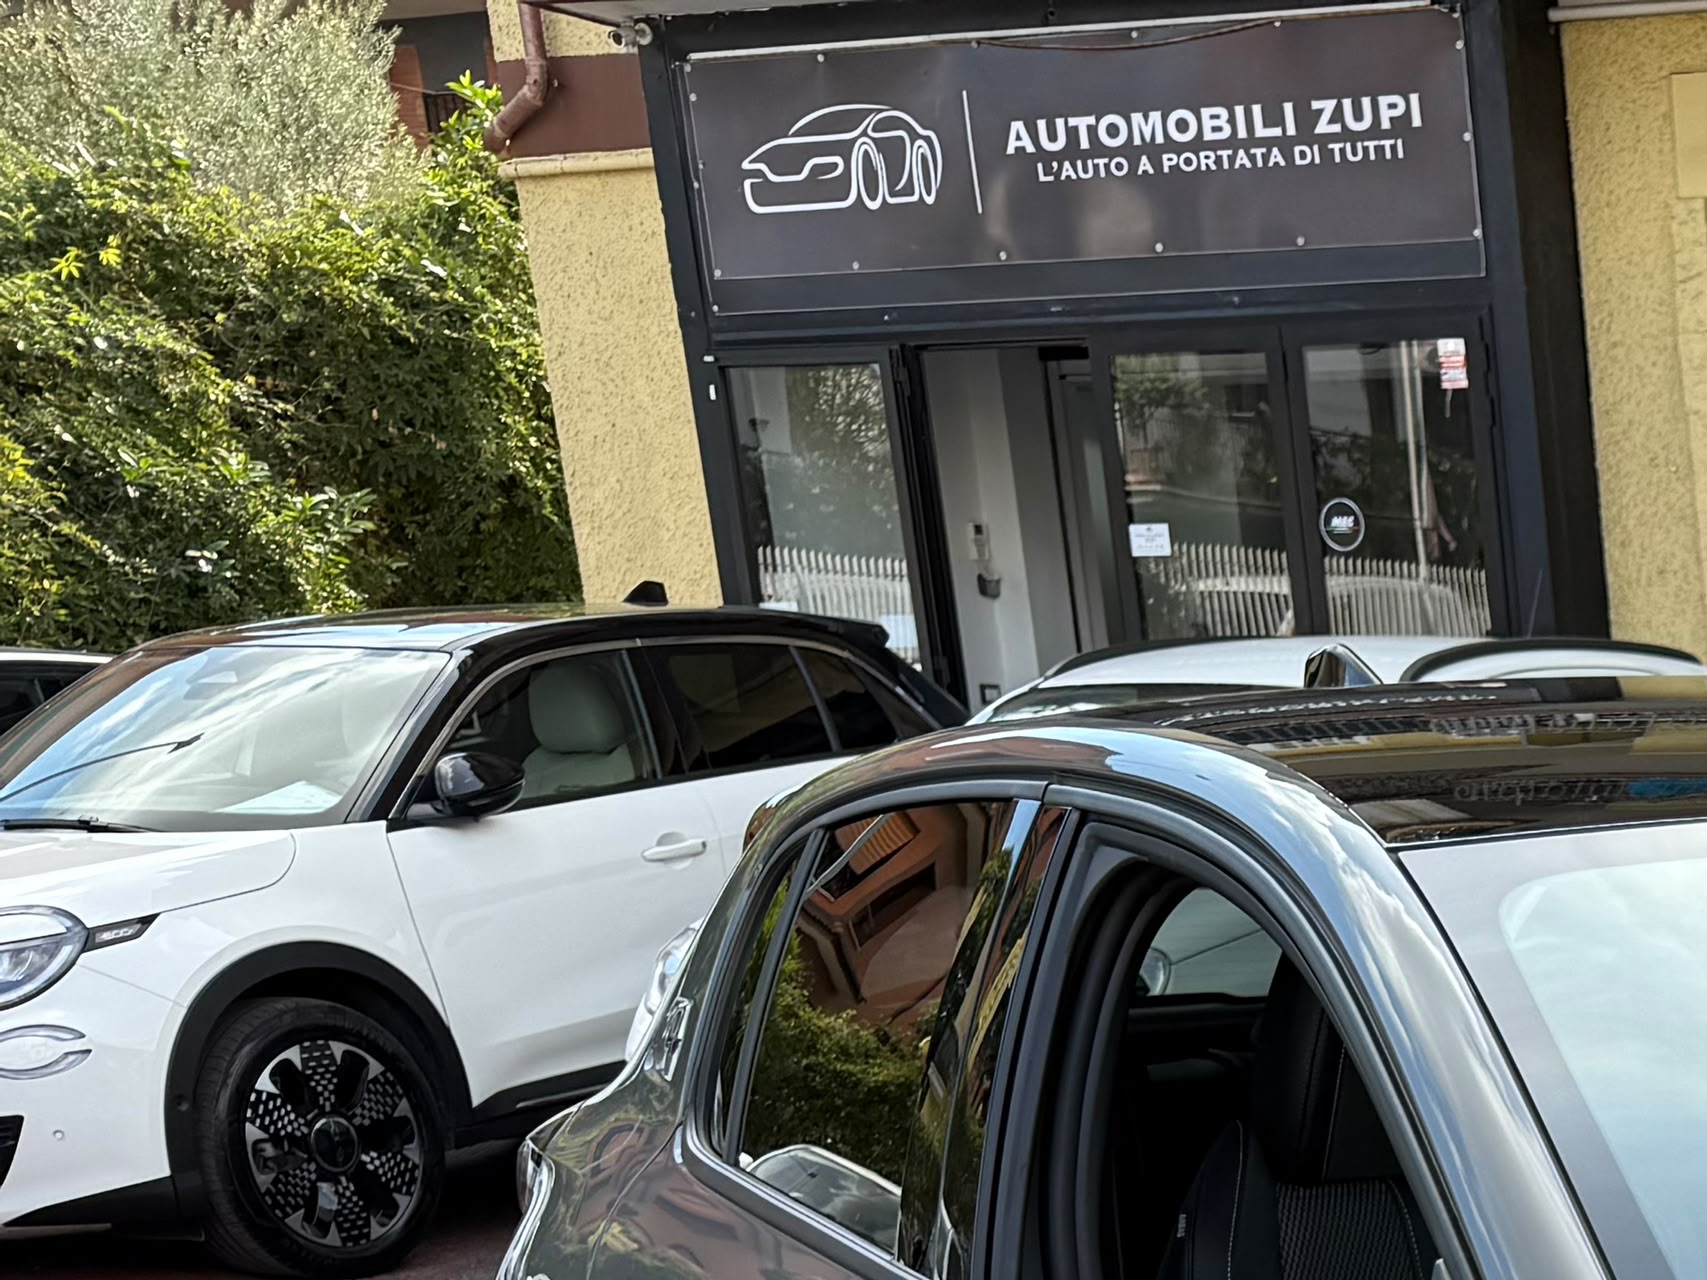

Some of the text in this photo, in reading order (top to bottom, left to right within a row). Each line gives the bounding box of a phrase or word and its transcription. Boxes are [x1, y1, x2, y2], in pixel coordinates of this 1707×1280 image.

[1005, 93, 1423, 155] AUTOMOBILI ZUPI
[1037, 139, 1404, 182] L'AUTO A PORTATA DI TUTTI
